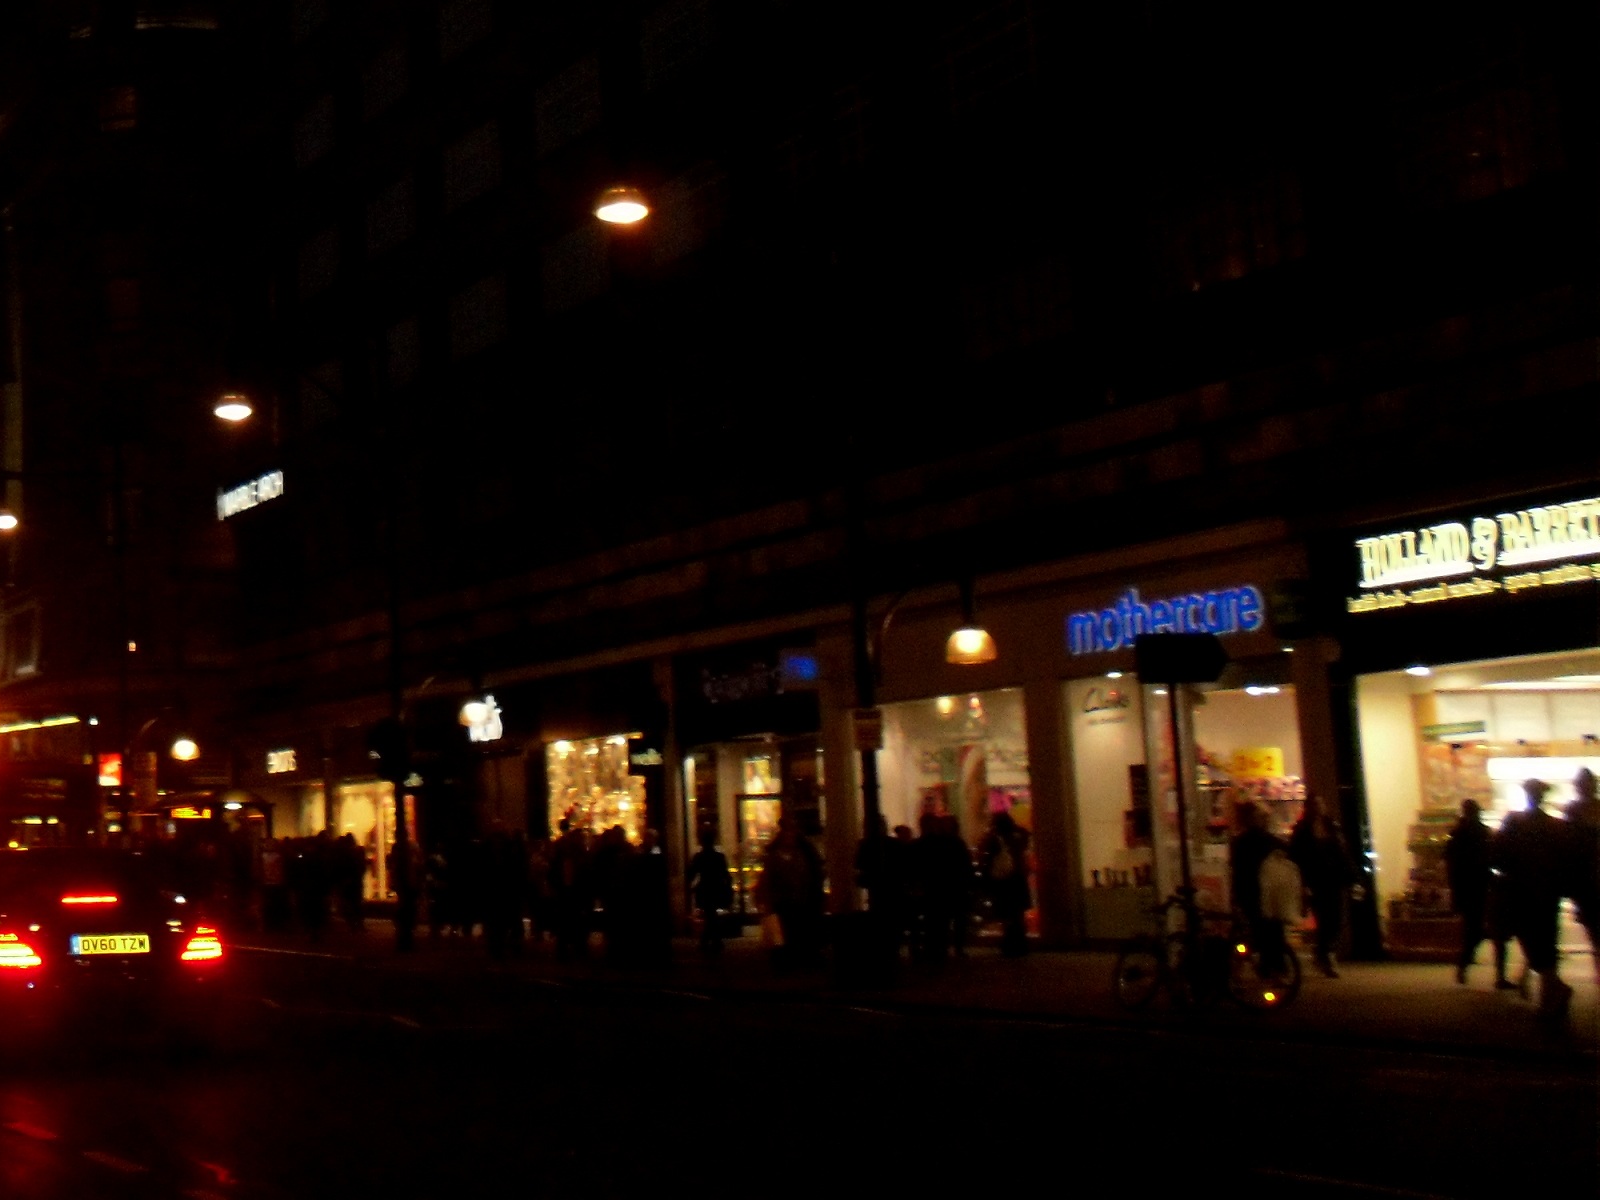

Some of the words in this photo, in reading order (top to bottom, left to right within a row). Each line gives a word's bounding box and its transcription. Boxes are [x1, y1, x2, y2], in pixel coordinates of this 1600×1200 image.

[1356, 522, 1474, 588] HOLLAND
[1471, 516, 1499, 571] &
[1496, 497, 1600, 566] BARRET
[1066, 586, 1266, 657] mothercare
